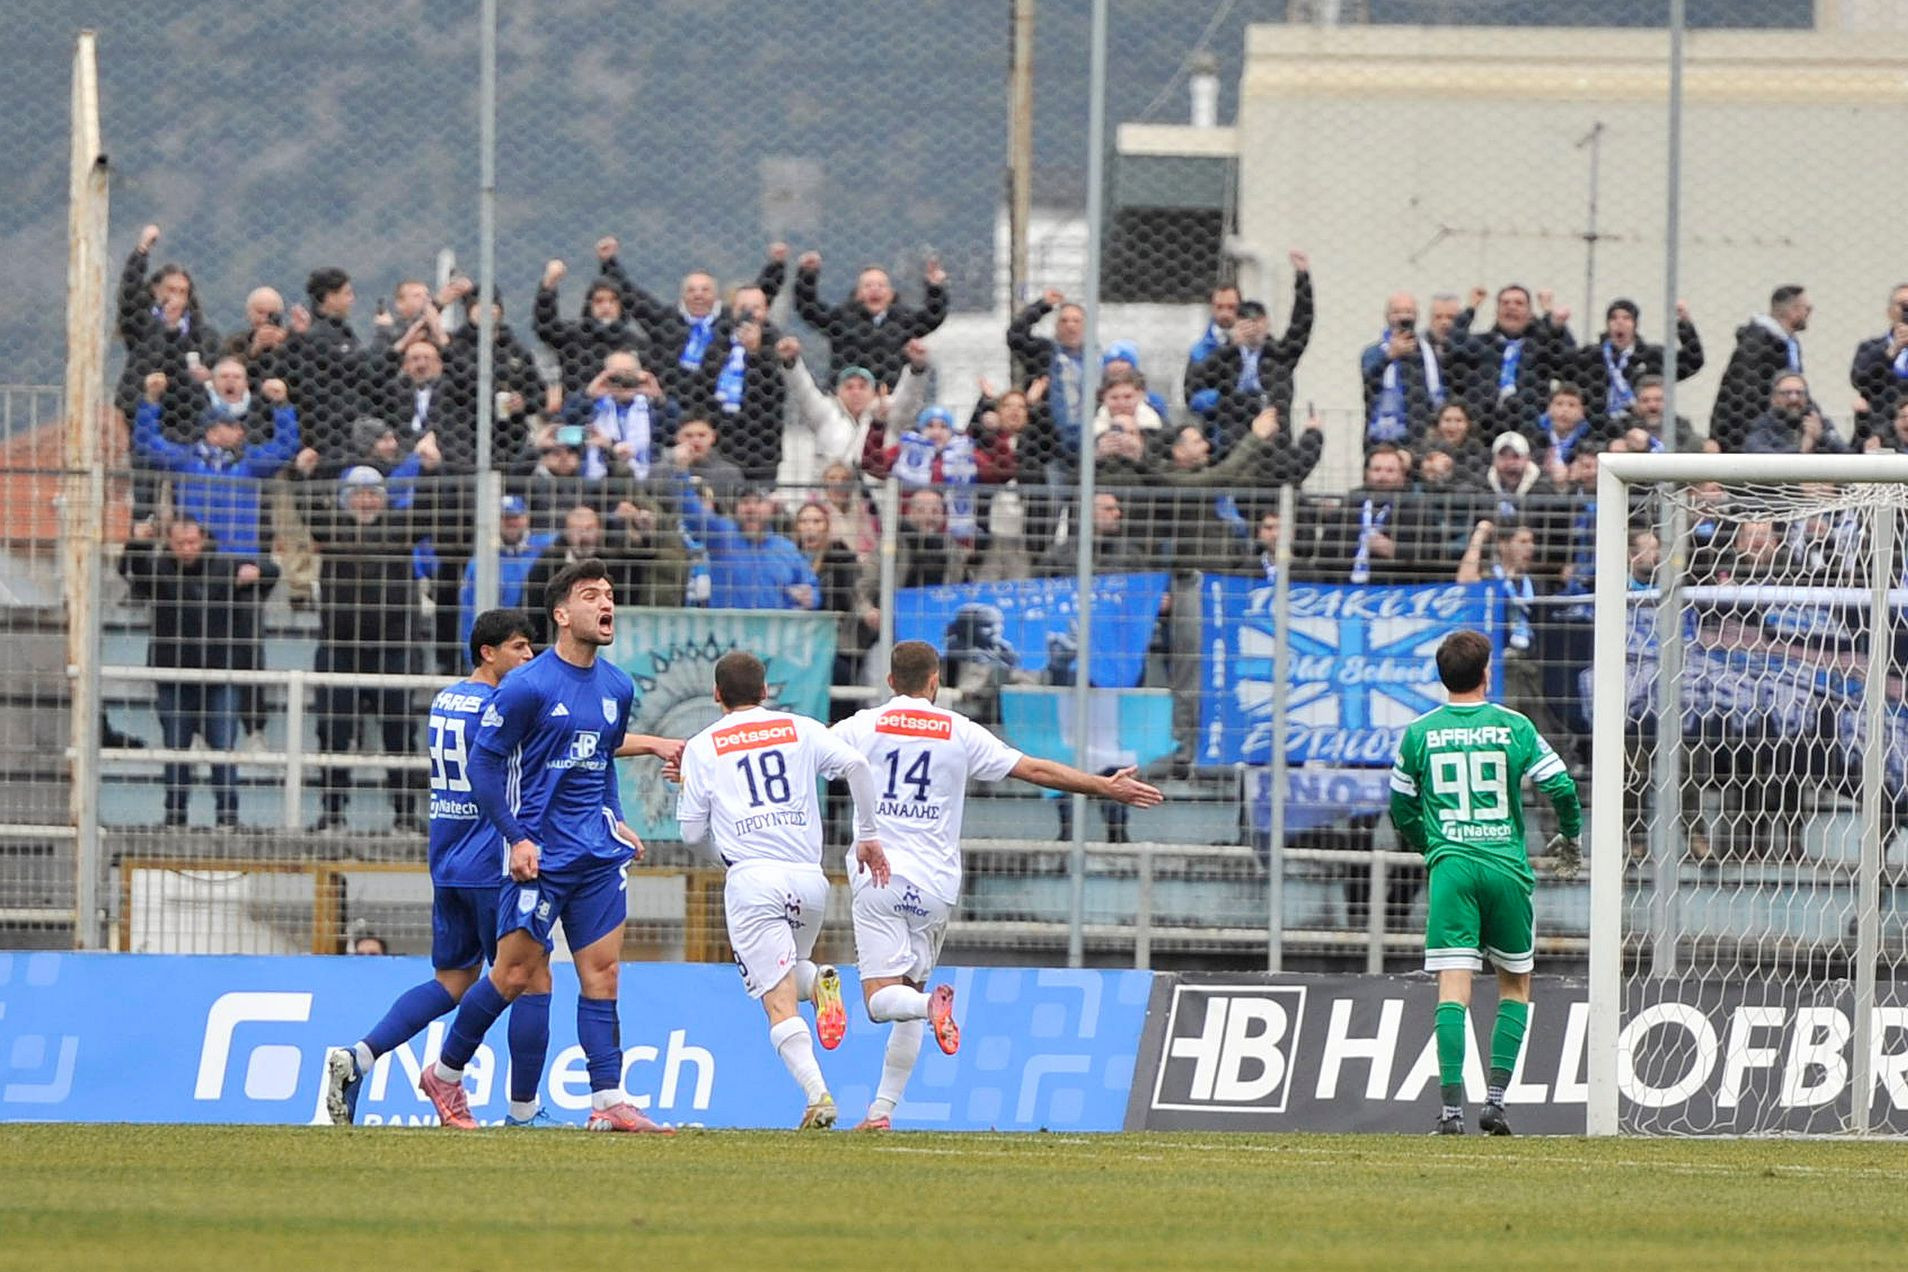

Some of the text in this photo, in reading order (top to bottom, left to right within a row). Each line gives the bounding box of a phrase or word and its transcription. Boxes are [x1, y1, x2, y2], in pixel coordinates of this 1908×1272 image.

[715, 724, 795, 748] betsson
[876, 711, 951, 733] betsson
[1426, 726, 1512, 748] ΒΡΑΚΑΣ
[429, 715, 472, 792] 33
[737, 749, 791, 808] 18
[885, 749, 932, 802] 14
[1430, 751, 1509, 821] 99
[439, 799, 479, 815] Natech
[875, 801, 940, 820] ΑΝΑΛΗΣ
[1463, 824, 1512, 837] Natech
[368, 1021, 715, 1110] Naech
[1171, 997, 1288, 1102] HB
